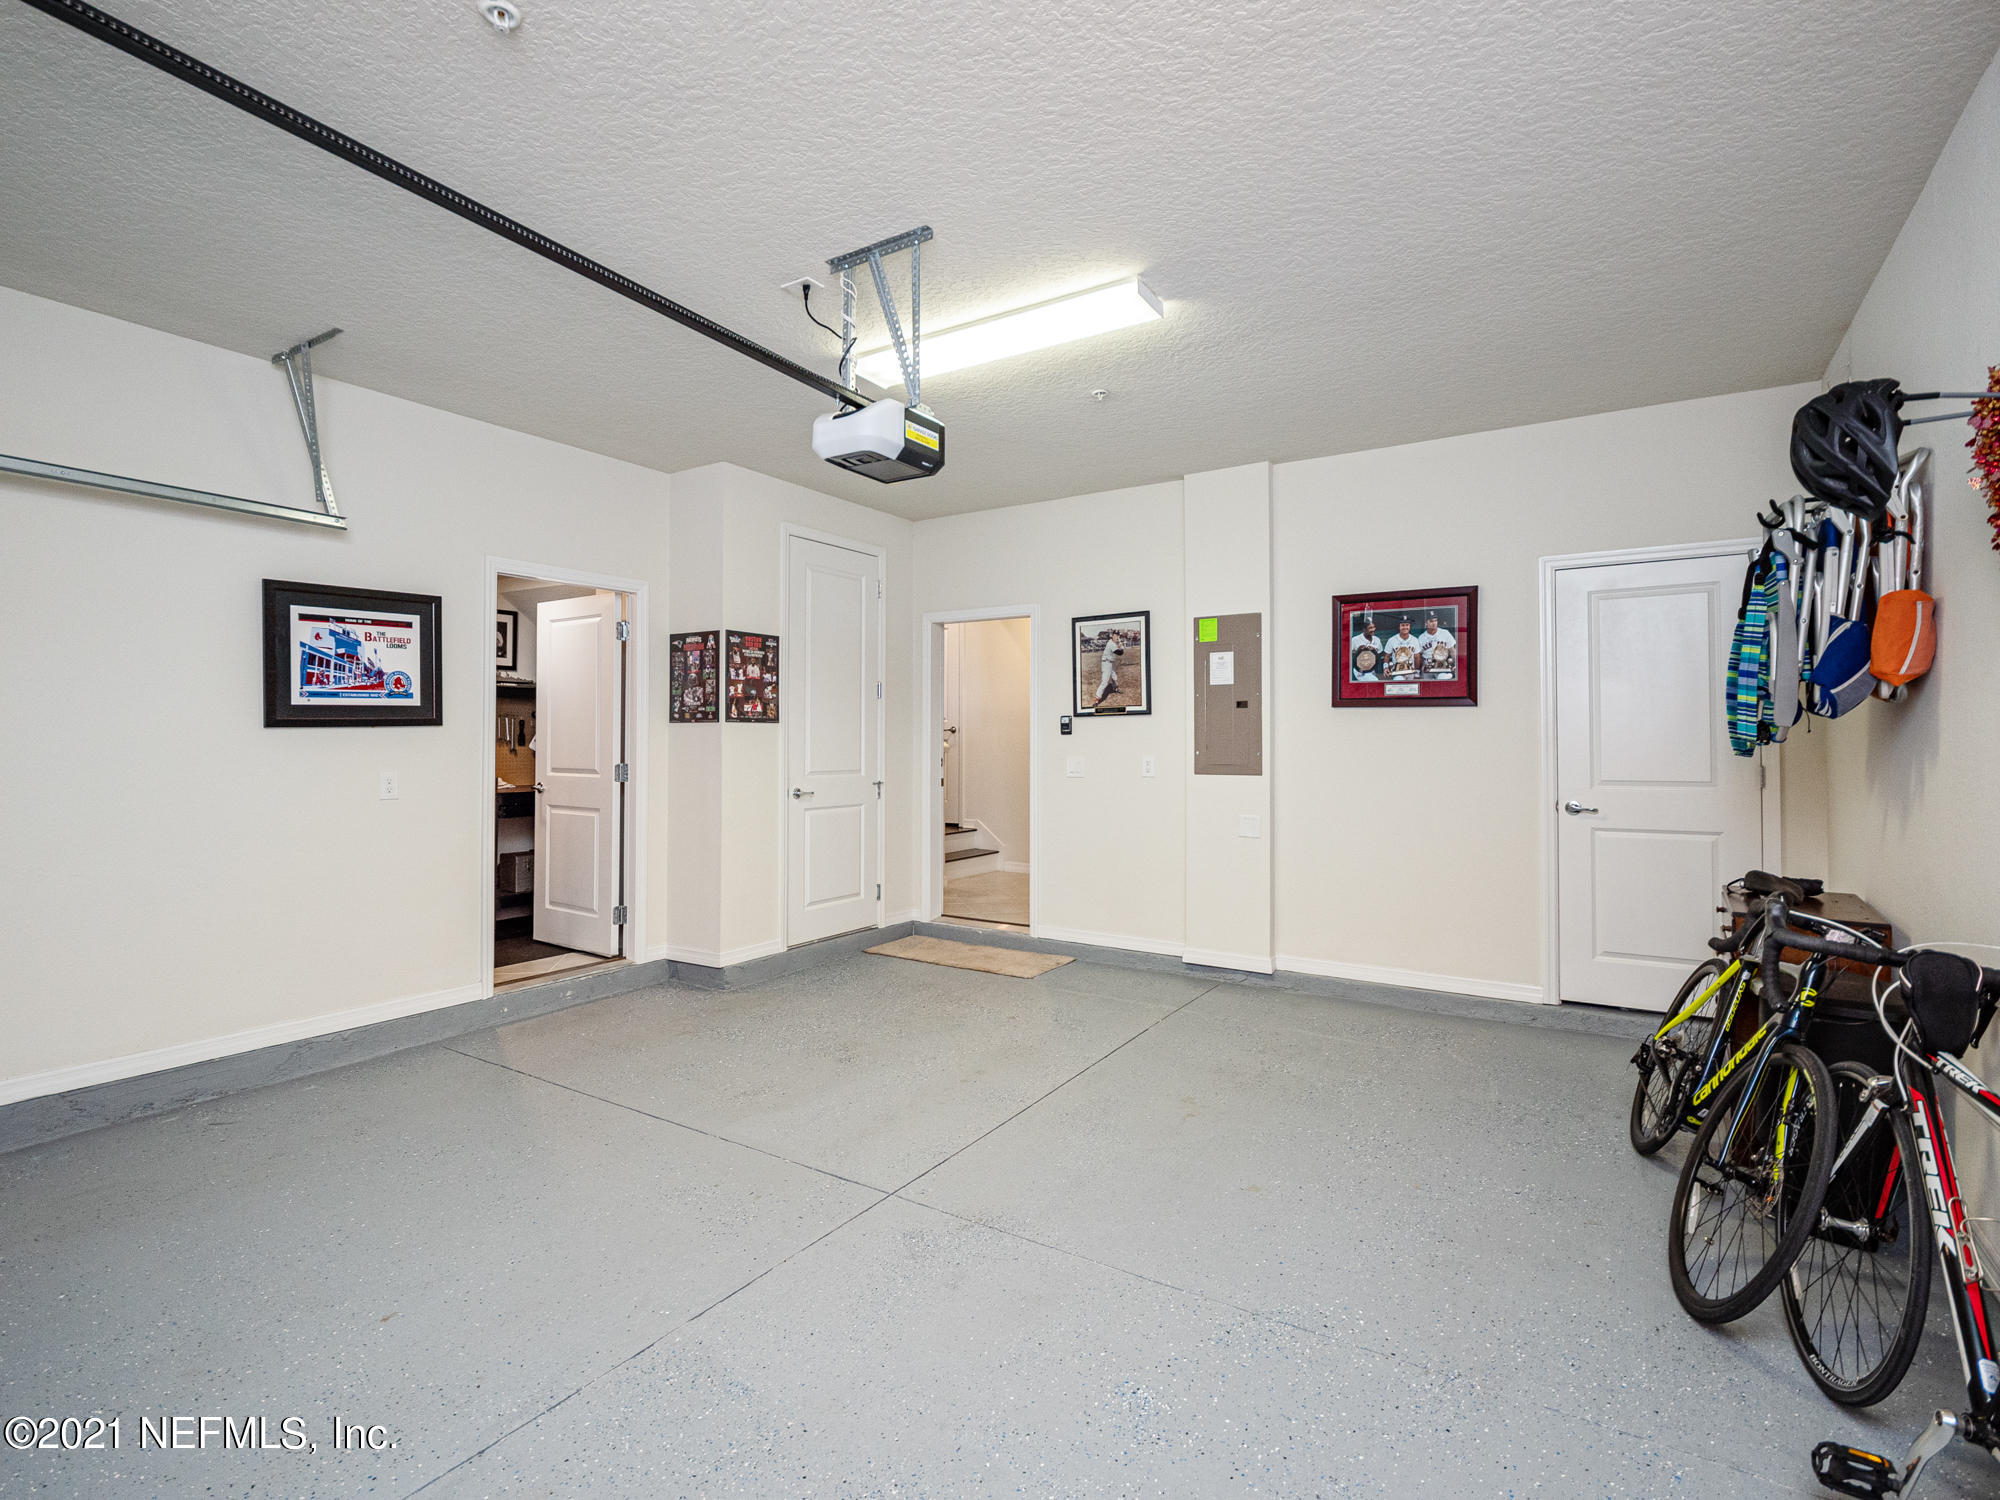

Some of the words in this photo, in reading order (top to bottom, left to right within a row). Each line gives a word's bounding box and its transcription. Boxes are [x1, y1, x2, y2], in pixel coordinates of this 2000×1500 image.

[364, 632, 411, 644] BATTLEFIELD
[1935, 1054, 1986, 1094] TREK
[1912, 1100, 1958, 1257] TREK
